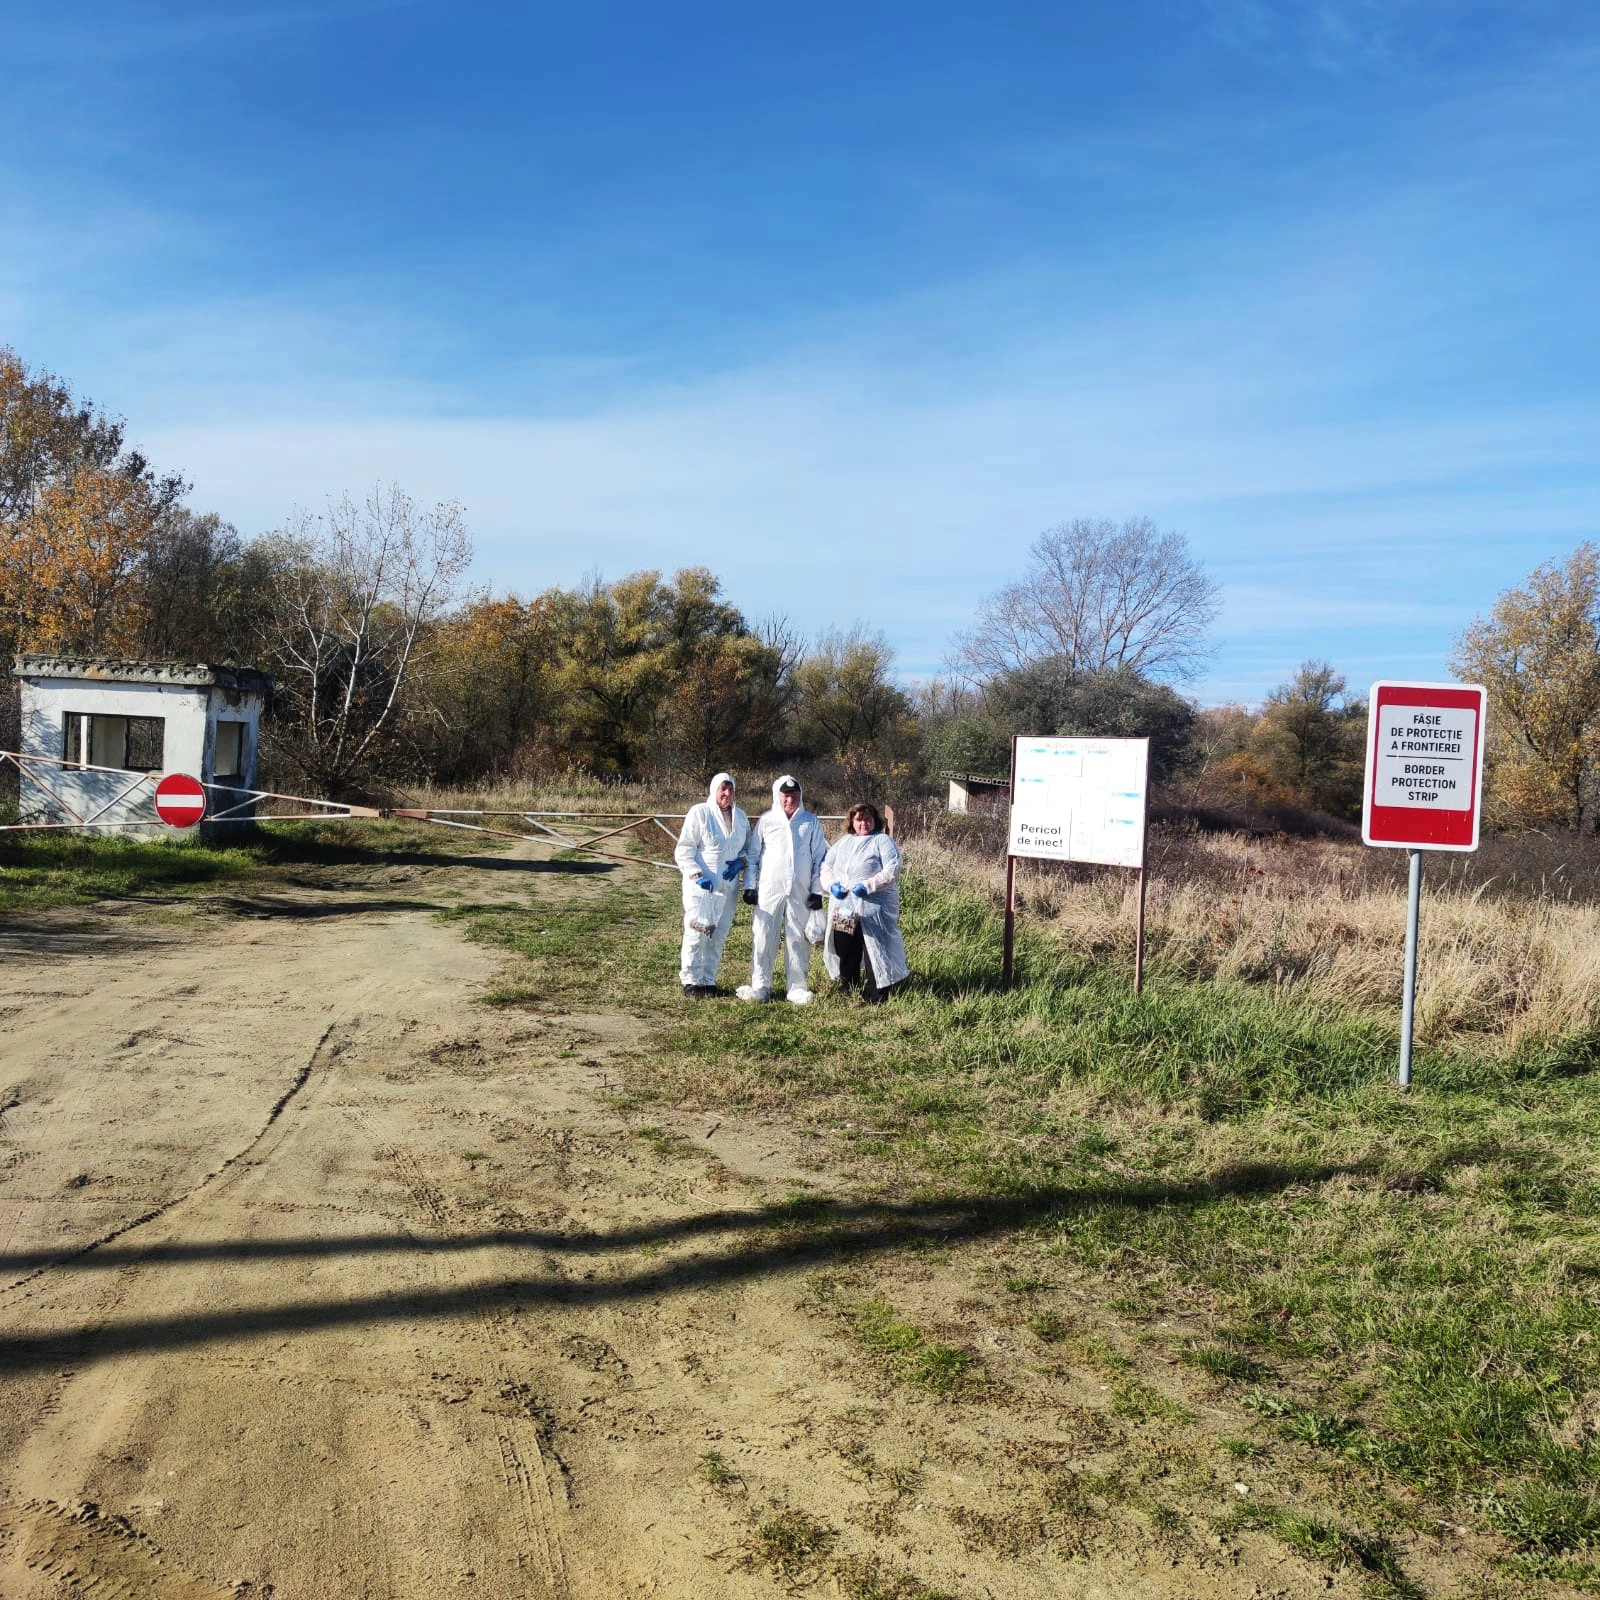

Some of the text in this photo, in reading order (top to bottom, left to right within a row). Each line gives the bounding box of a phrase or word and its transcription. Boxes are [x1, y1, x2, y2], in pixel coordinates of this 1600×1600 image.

[1391, 727, 1463, 742] DE PROTECȚIE
[1391, 741, 1460, 753] A FRONTIEREI
[1404, 764, 1445, 775] BORDER
[1391, 777, 1456, 789] PROTECTION
[1408, 791, 1438, 801] STRIP
[1021, 823, 1061, 835] Pericol
[1017, 836, 1063, 848] de inec!
